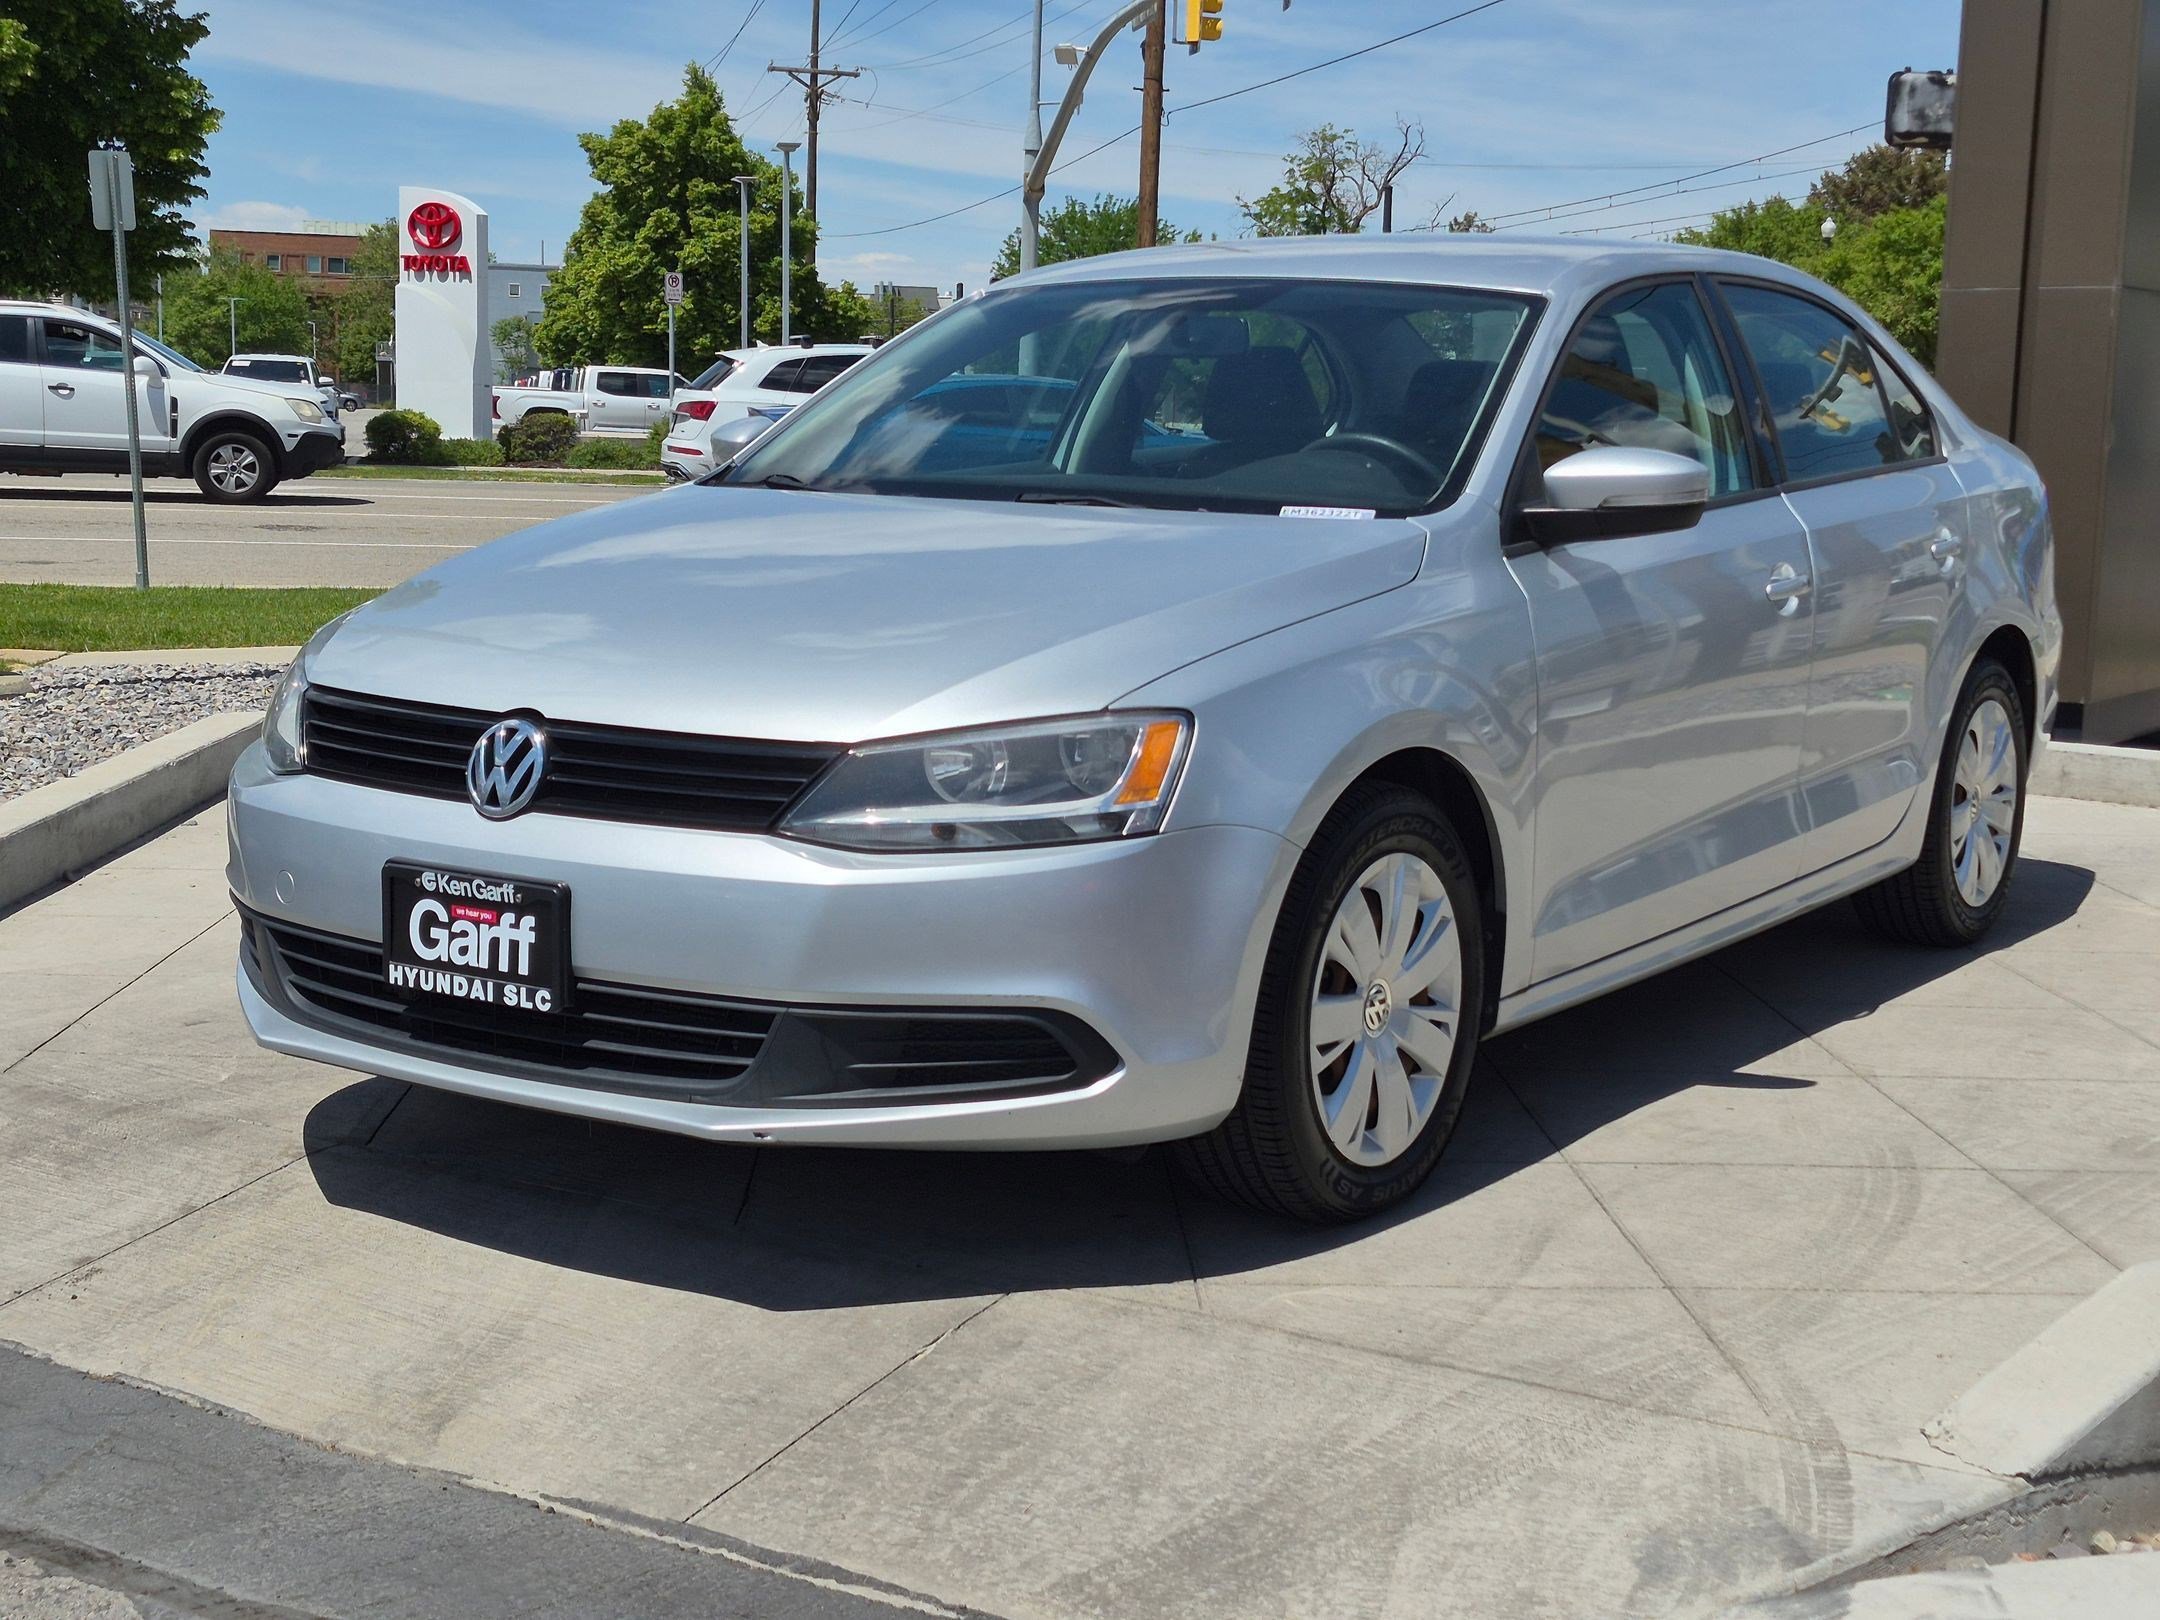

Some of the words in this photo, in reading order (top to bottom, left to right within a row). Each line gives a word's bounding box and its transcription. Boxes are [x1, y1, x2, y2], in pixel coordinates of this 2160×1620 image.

[400, 255, 471, 273] TOYOTA
[465, 908, 480, 918] hear
[480, 911, 492, 921] you
[409, 899, 536, 976] Garff
[389, 964, 494, 1002] HYUNDAI
[503, 984, 552, 1012] SLC
